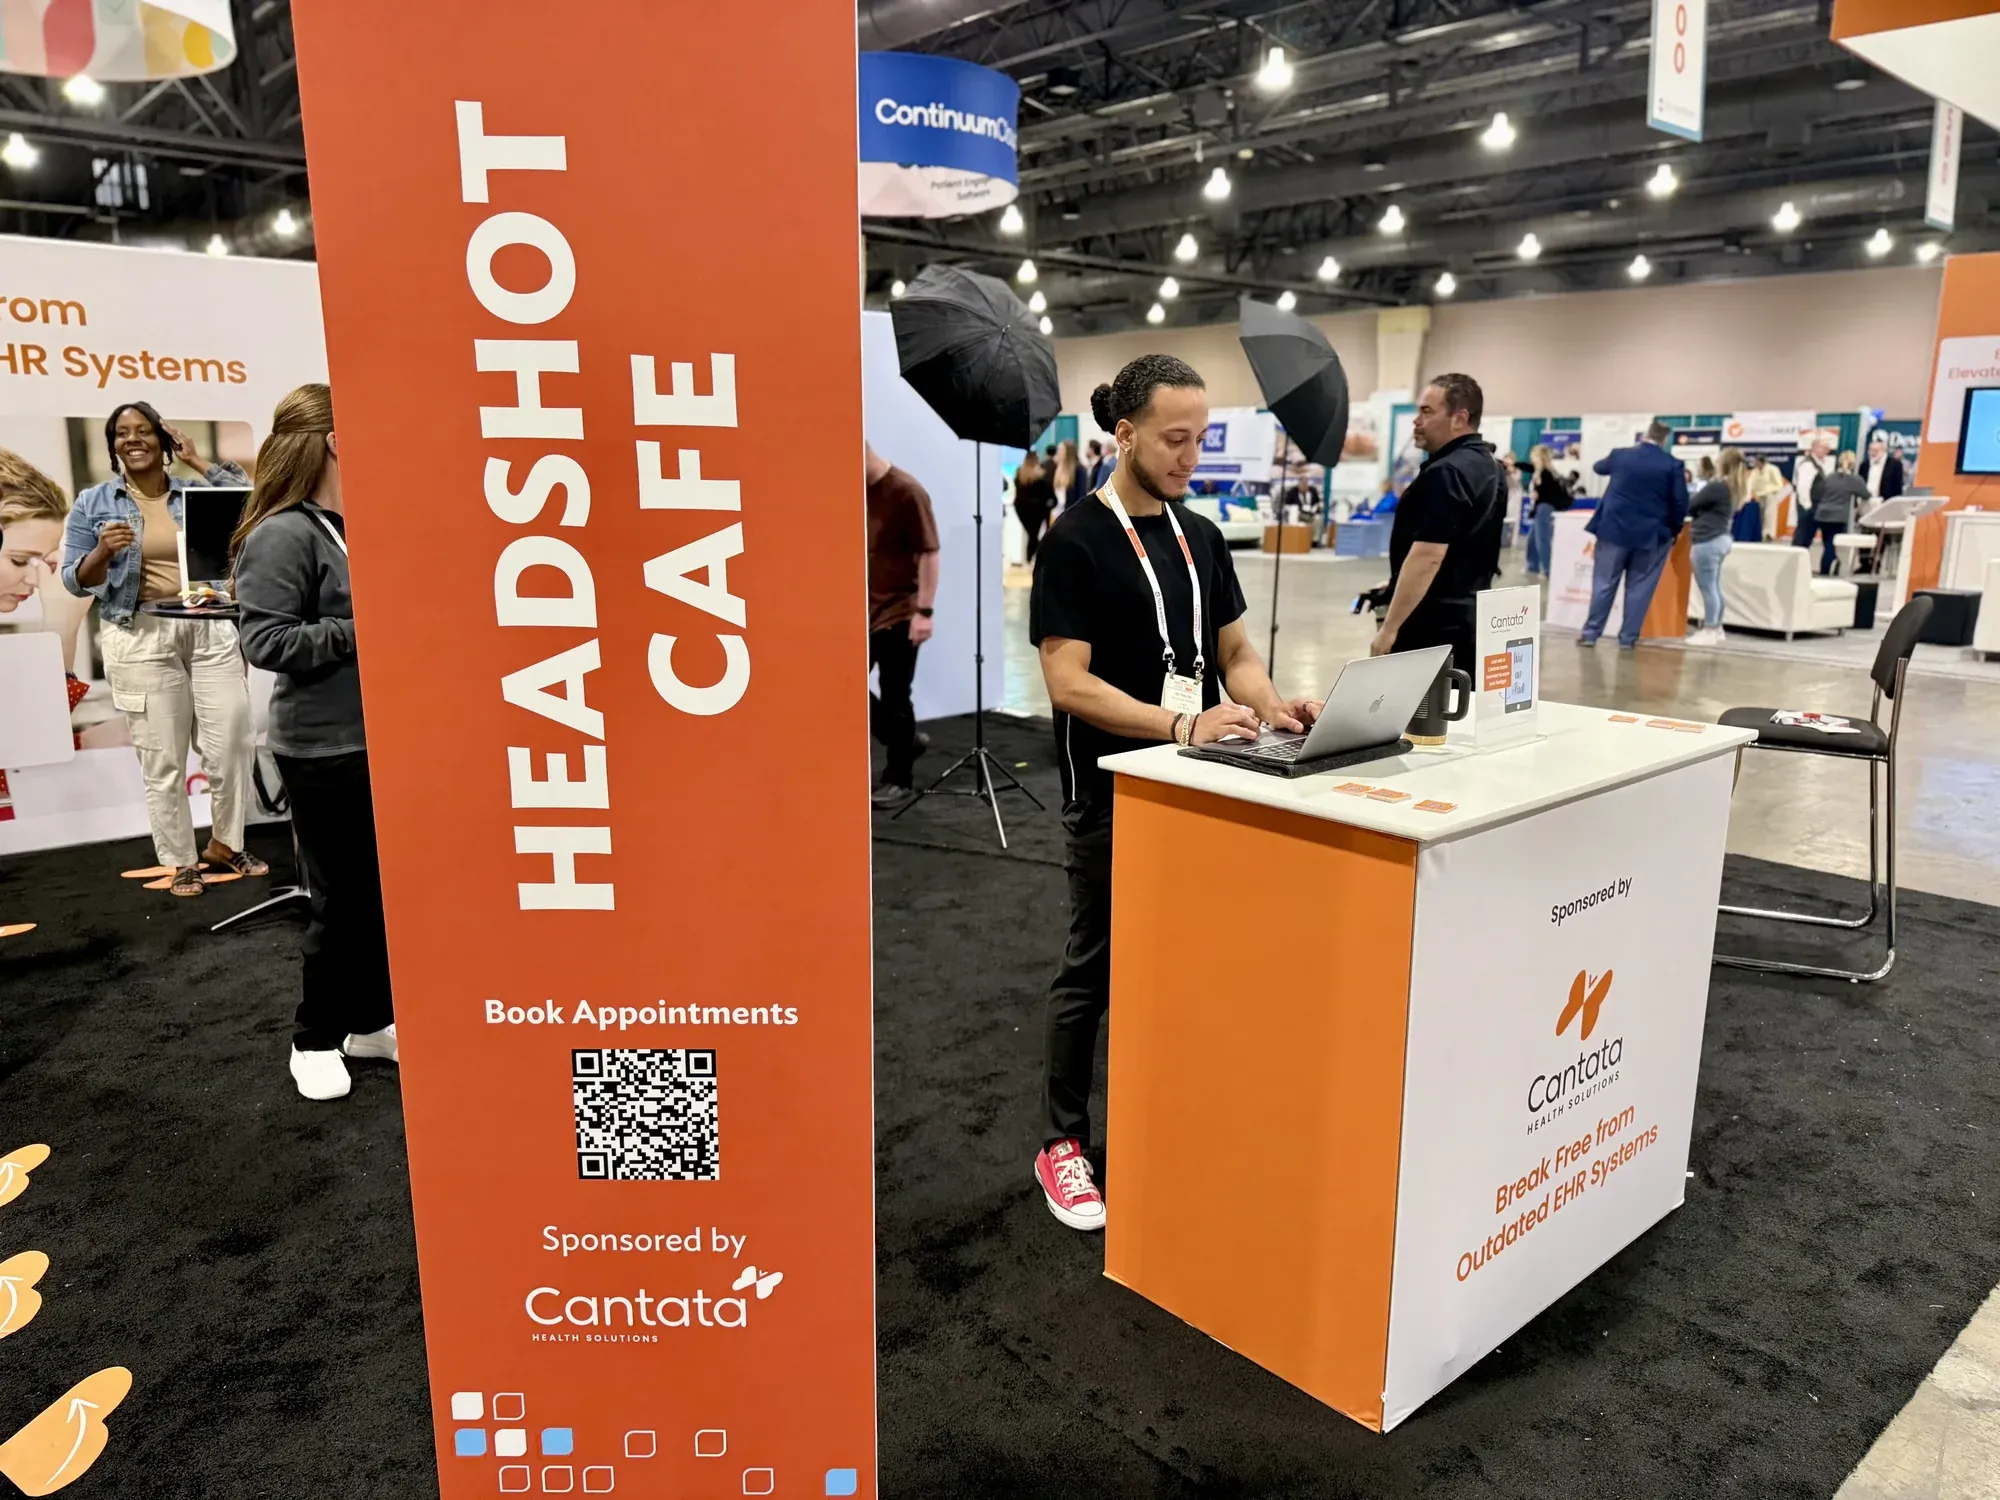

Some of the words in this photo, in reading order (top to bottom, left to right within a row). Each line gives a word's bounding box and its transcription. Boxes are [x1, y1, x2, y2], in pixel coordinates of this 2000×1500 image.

[62, 345, 248, 389] Systems
[454, 99, 615, 911] HEADSHOT
[630, 351, 752, 716] CAFE
[1490, 613, 1524, 629] Cantata
[1550, 880, 1616, 927] Sponsored
[1617, 877, 1633, 898] by
[484, 999, 565, 1025] Book
[571, 998, 800, 1031] Appointments
[1527, 1035, 1625, 1113] Cantata
[1526, 1104, 1565, 1136] HEALTH
[1567, 1070, 1621, 1110] SOLUTIONS
[1495, 1156, 1552, 1215] Break
[1554, 1133, 1592, 1174] Free
[1595, 1104, 1635, 1146] from
[1455, 1192, 1550, 1283] Outdated
[1553, 1169, 1587, 1213] EHR
[1590, 1123, 1659, 1188] Systems
[542, 1225, 702, 1257] Sponsored
[711, 1226, 747, 1259] by
[525, 1286, 748, 1328] Cantata
[531, 1333, 580, 1342] HEALTH
[585, 1333, 659, 1343] SOLUTIONS
